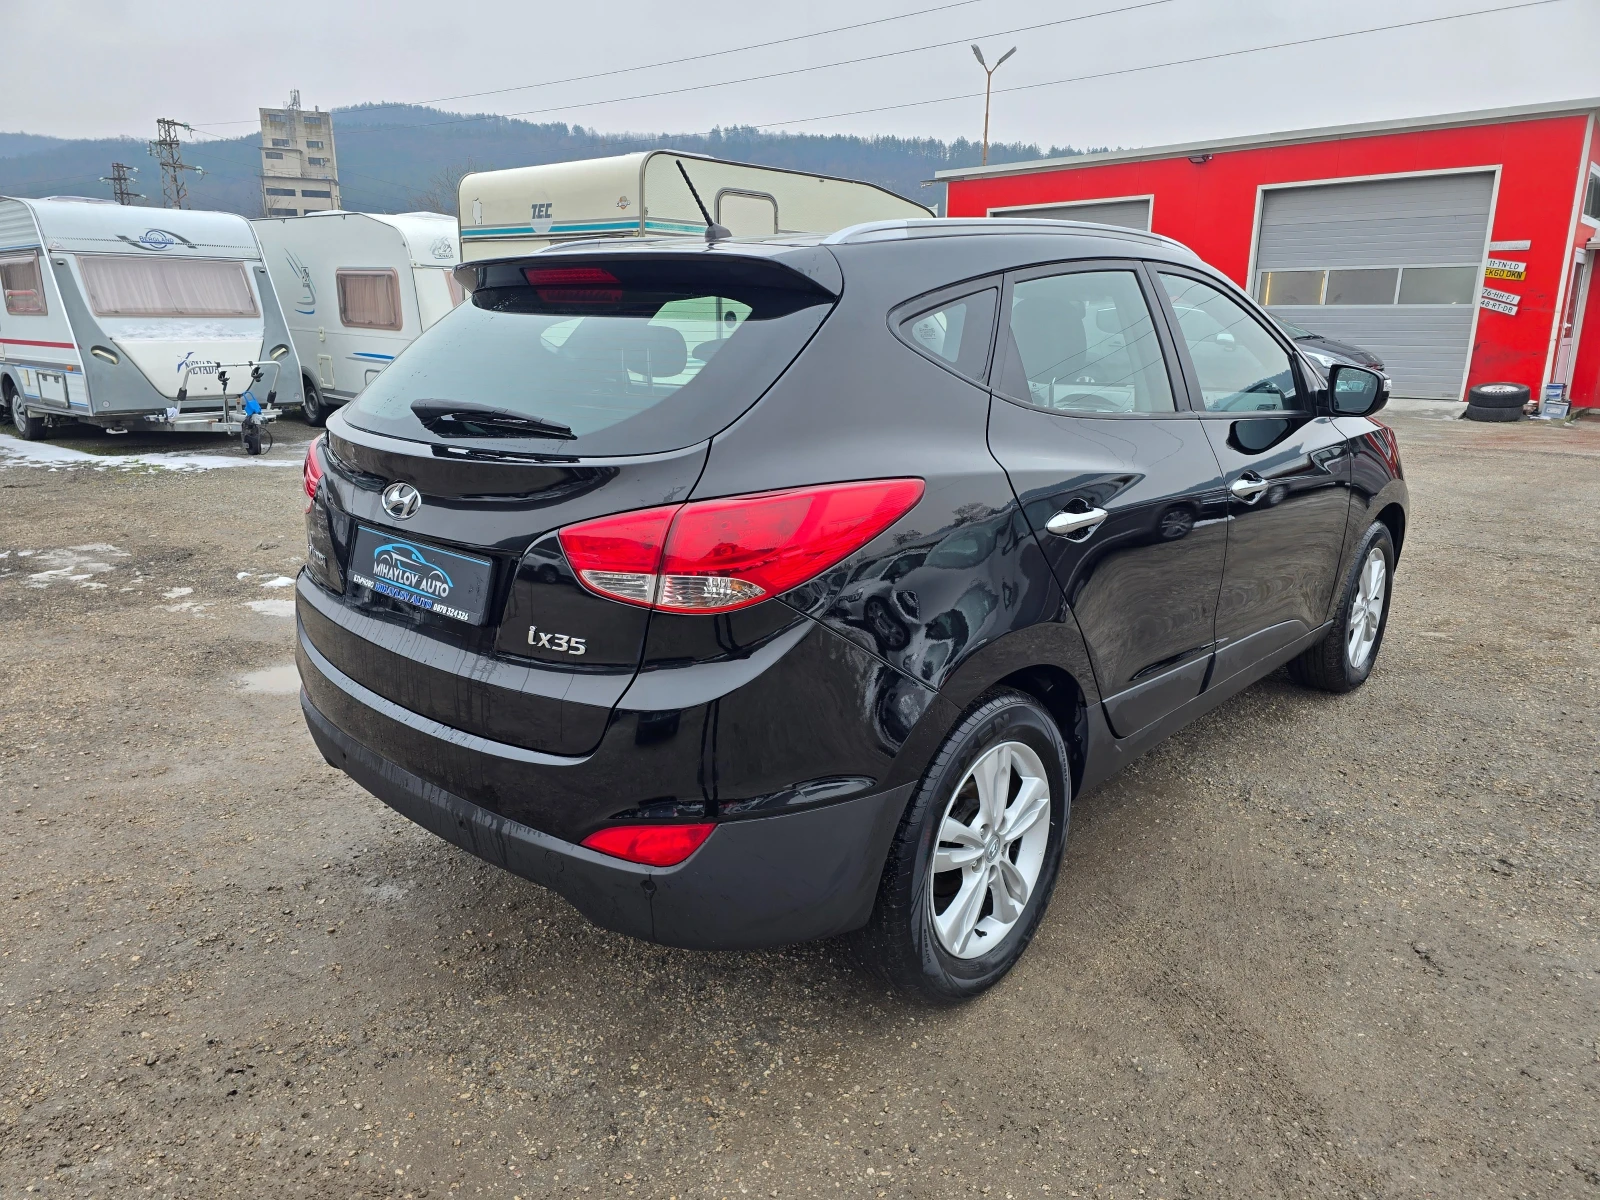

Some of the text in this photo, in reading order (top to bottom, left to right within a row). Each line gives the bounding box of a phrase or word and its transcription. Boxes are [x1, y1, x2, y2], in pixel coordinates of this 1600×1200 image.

[373, 562, 449, 597] MIHAYLOV AUTO
[527, 625, 587, 656] ix35
